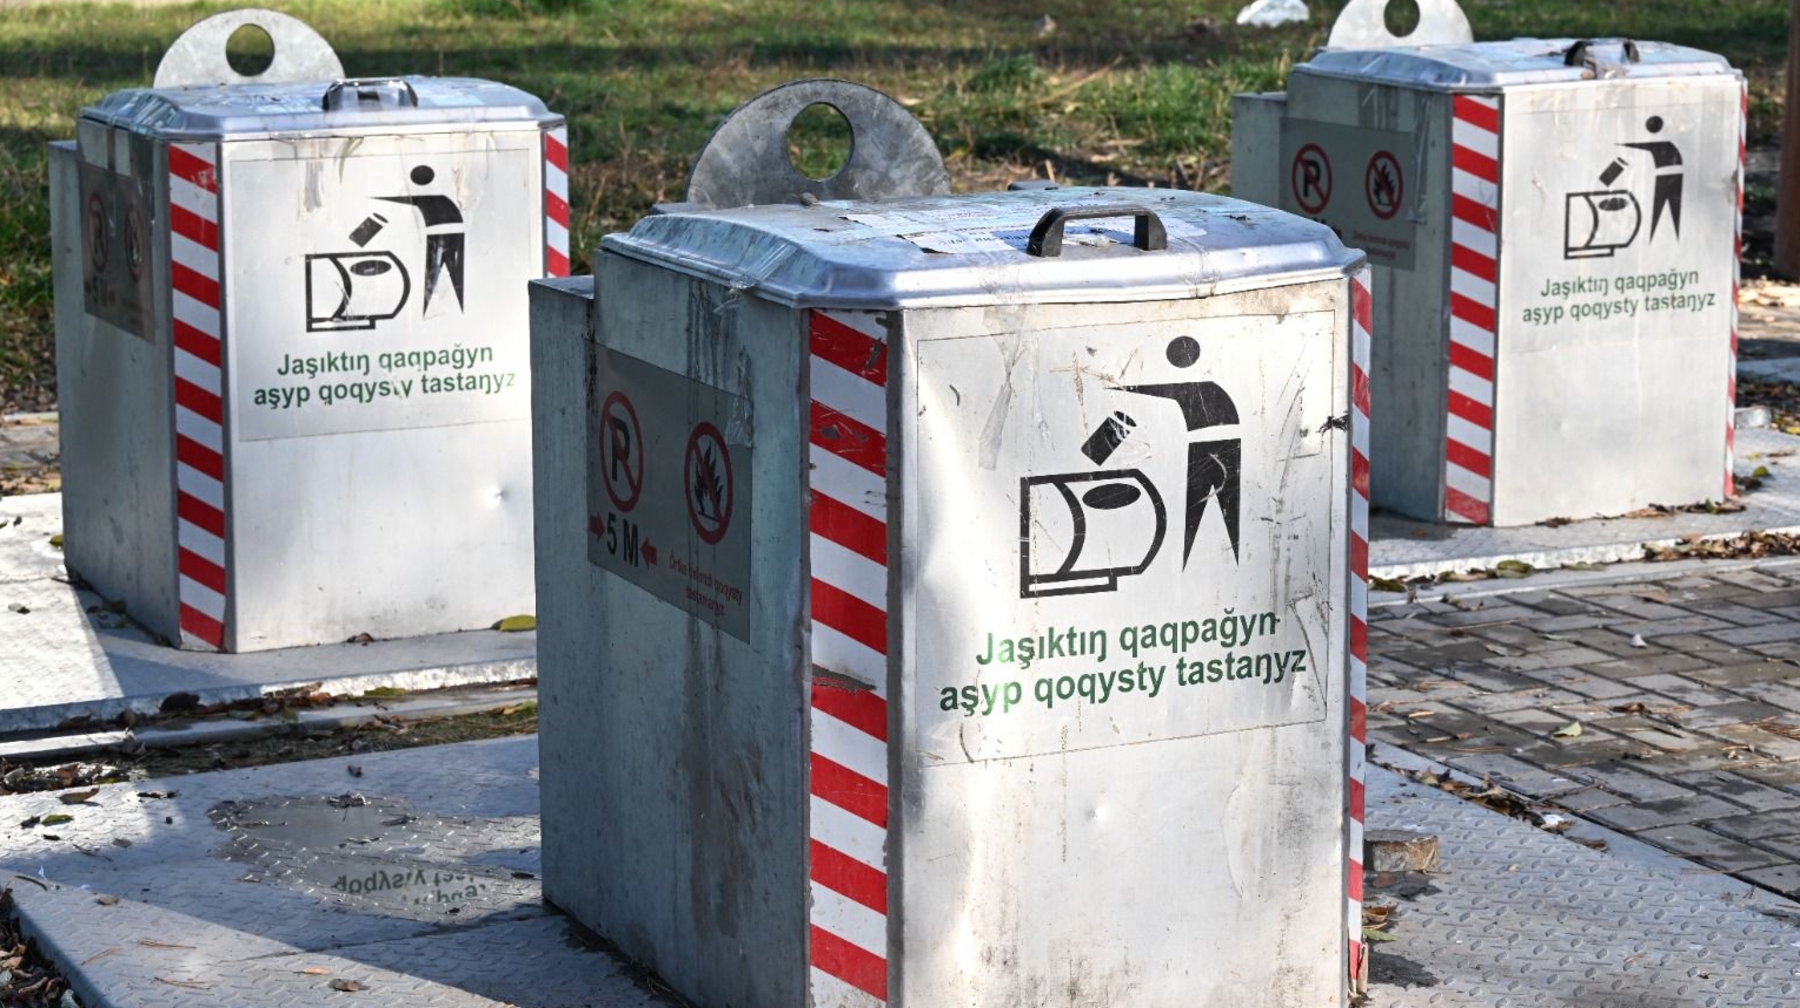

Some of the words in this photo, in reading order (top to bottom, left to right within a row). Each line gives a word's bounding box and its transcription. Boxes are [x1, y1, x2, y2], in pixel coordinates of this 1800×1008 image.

[1614, 268, 1699, 293] qaqpağyn
[1522, 306, 1564, 326] aşyp
[1570, 298, 1639, 320] qoqysty
[277, 351, 370, 379] Jaşıktıŋ
[378, 343, 493, 373] qaqpağyn
[254, 385, 310, 410] aşyp
[607, 512, 618, 555] 5
[623, 518, 639, 568] M
[975, 626, 1107, 670] Jaşıktıŋ
[1119, 607, 1278, 657] qaqpağyn
[939, 680, 1023, 717] aşyp
[1034, 661, 1167, 709] qoqysty
[1176, 648, 1307, 687] tastaŋyz
